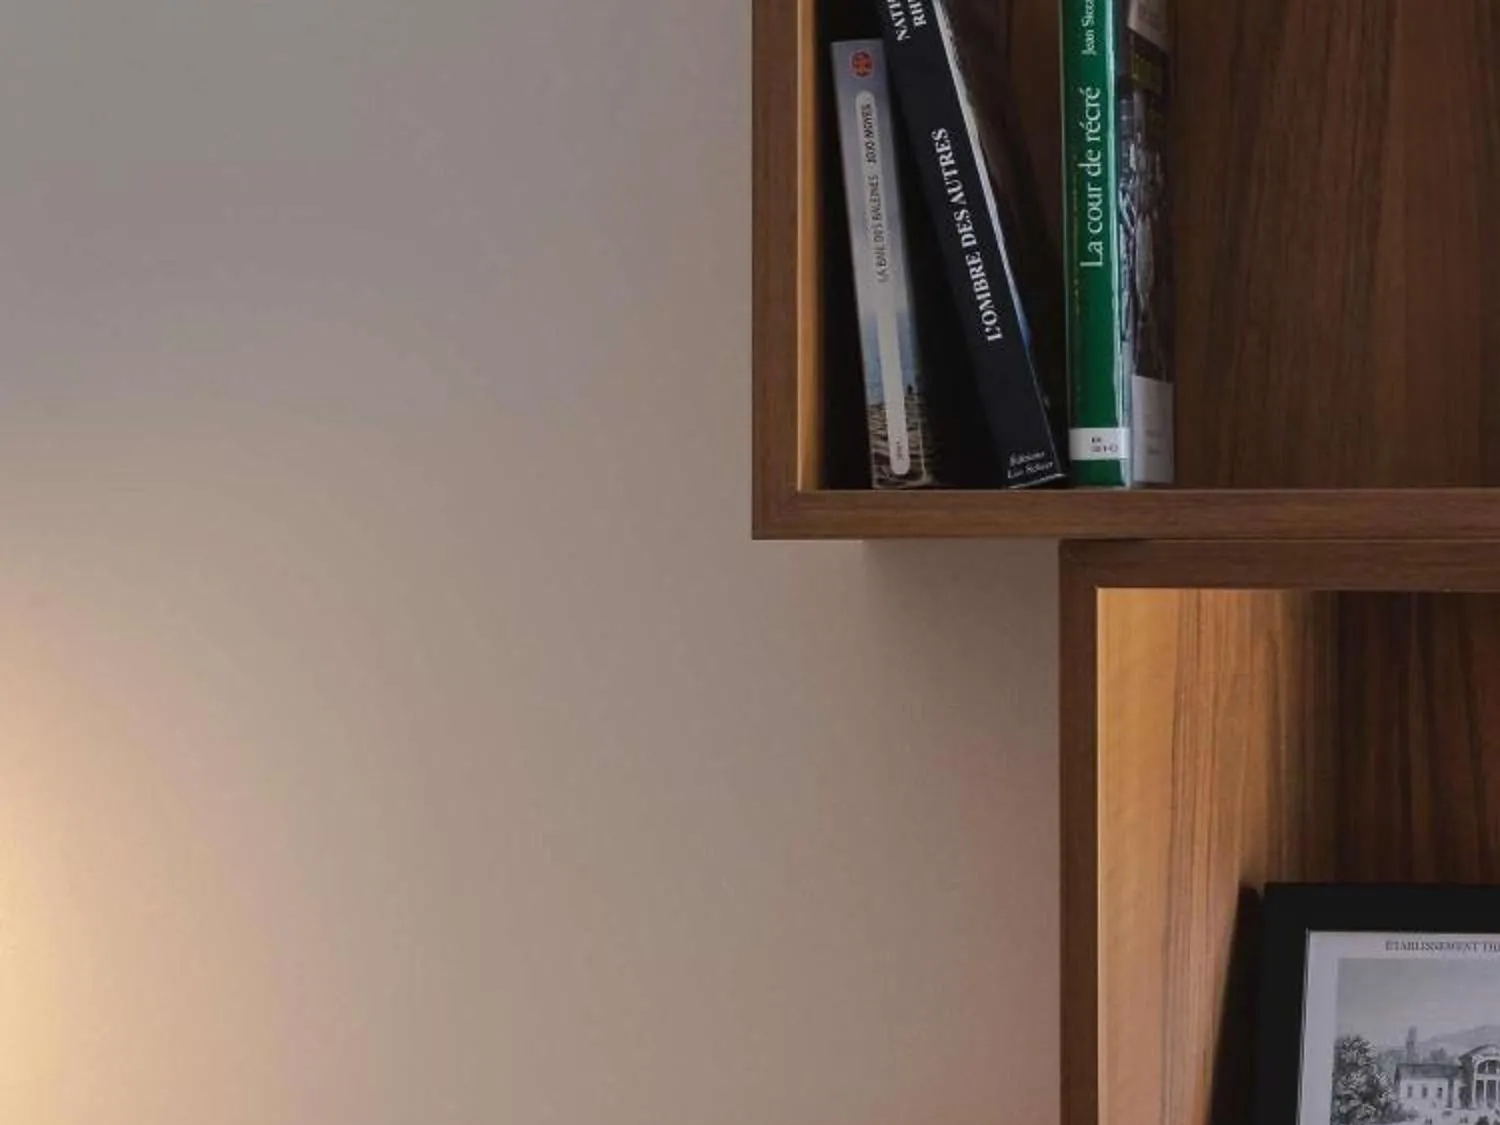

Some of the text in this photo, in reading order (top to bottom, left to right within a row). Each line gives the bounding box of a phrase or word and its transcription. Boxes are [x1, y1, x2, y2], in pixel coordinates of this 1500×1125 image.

[931, 127, 1003, 342] L'OMBRE DES AUTRES
[1076, 86, 1104, 268] La cour de récré
